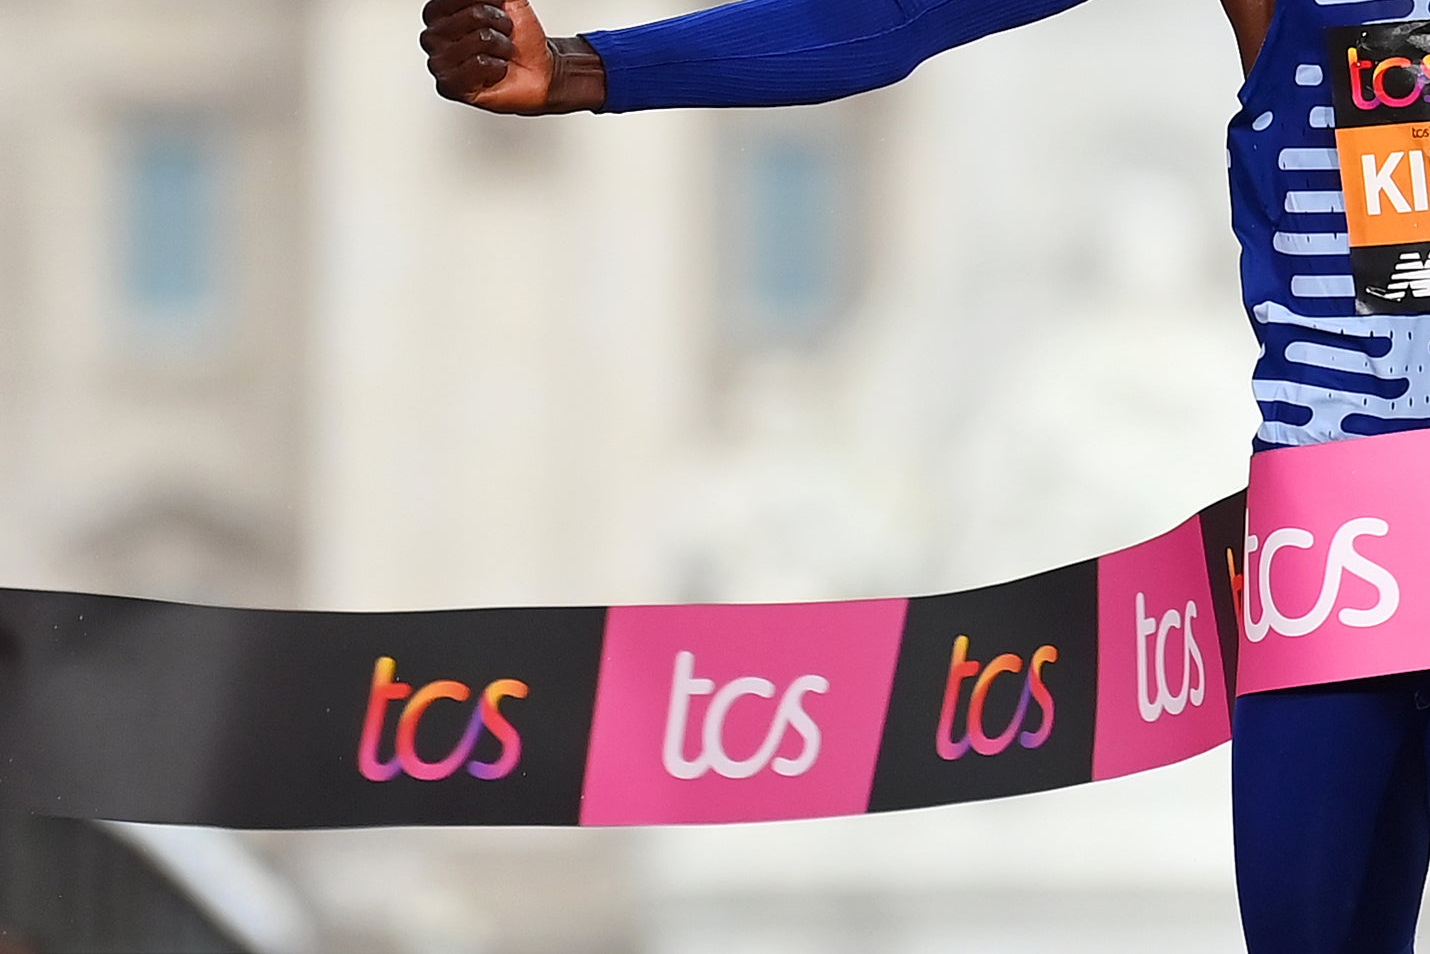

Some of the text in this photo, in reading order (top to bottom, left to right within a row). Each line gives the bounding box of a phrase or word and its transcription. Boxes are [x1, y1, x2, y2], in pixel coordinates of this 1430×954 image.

[358, 656, 528, 781] tcs
[661, 650, 829, 779] tcs
[936, 635, 1058, 761] tcs
[1135, 592, 1205, 722] tcs
